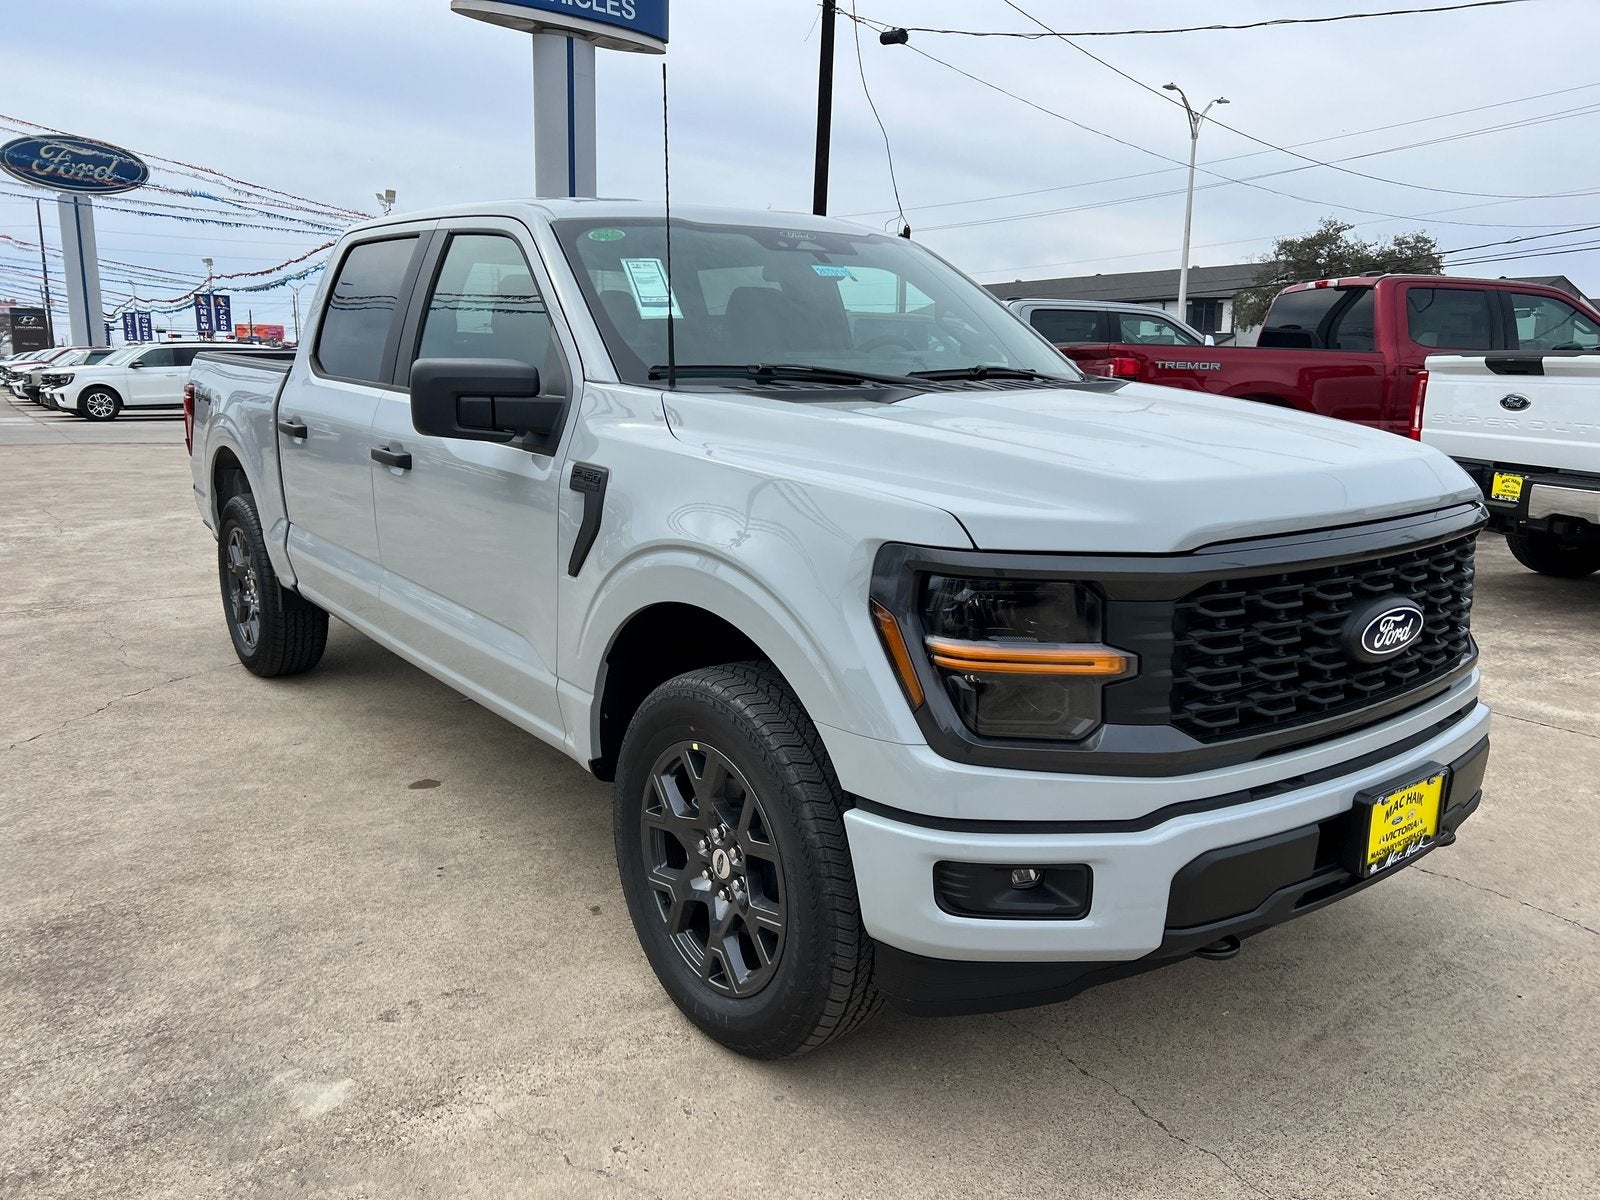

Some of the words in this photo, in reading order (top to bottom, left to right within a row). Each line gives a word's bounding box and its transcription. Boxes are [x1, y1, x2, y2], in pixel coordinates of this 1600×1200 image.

[31, 143, 119, 181] Ford
[199, 308, 210, 330] NEW
[219, 309, 227, 331] FORD
[1155, 360, 1221, 371] TREMOR
[1431, 413, 1521, 430] SUPER
[1373, 613, 1415, 649] Ford
[1383, 795, 1406, 823] MAC
[1405, 791, 1425, 807] HAIK
